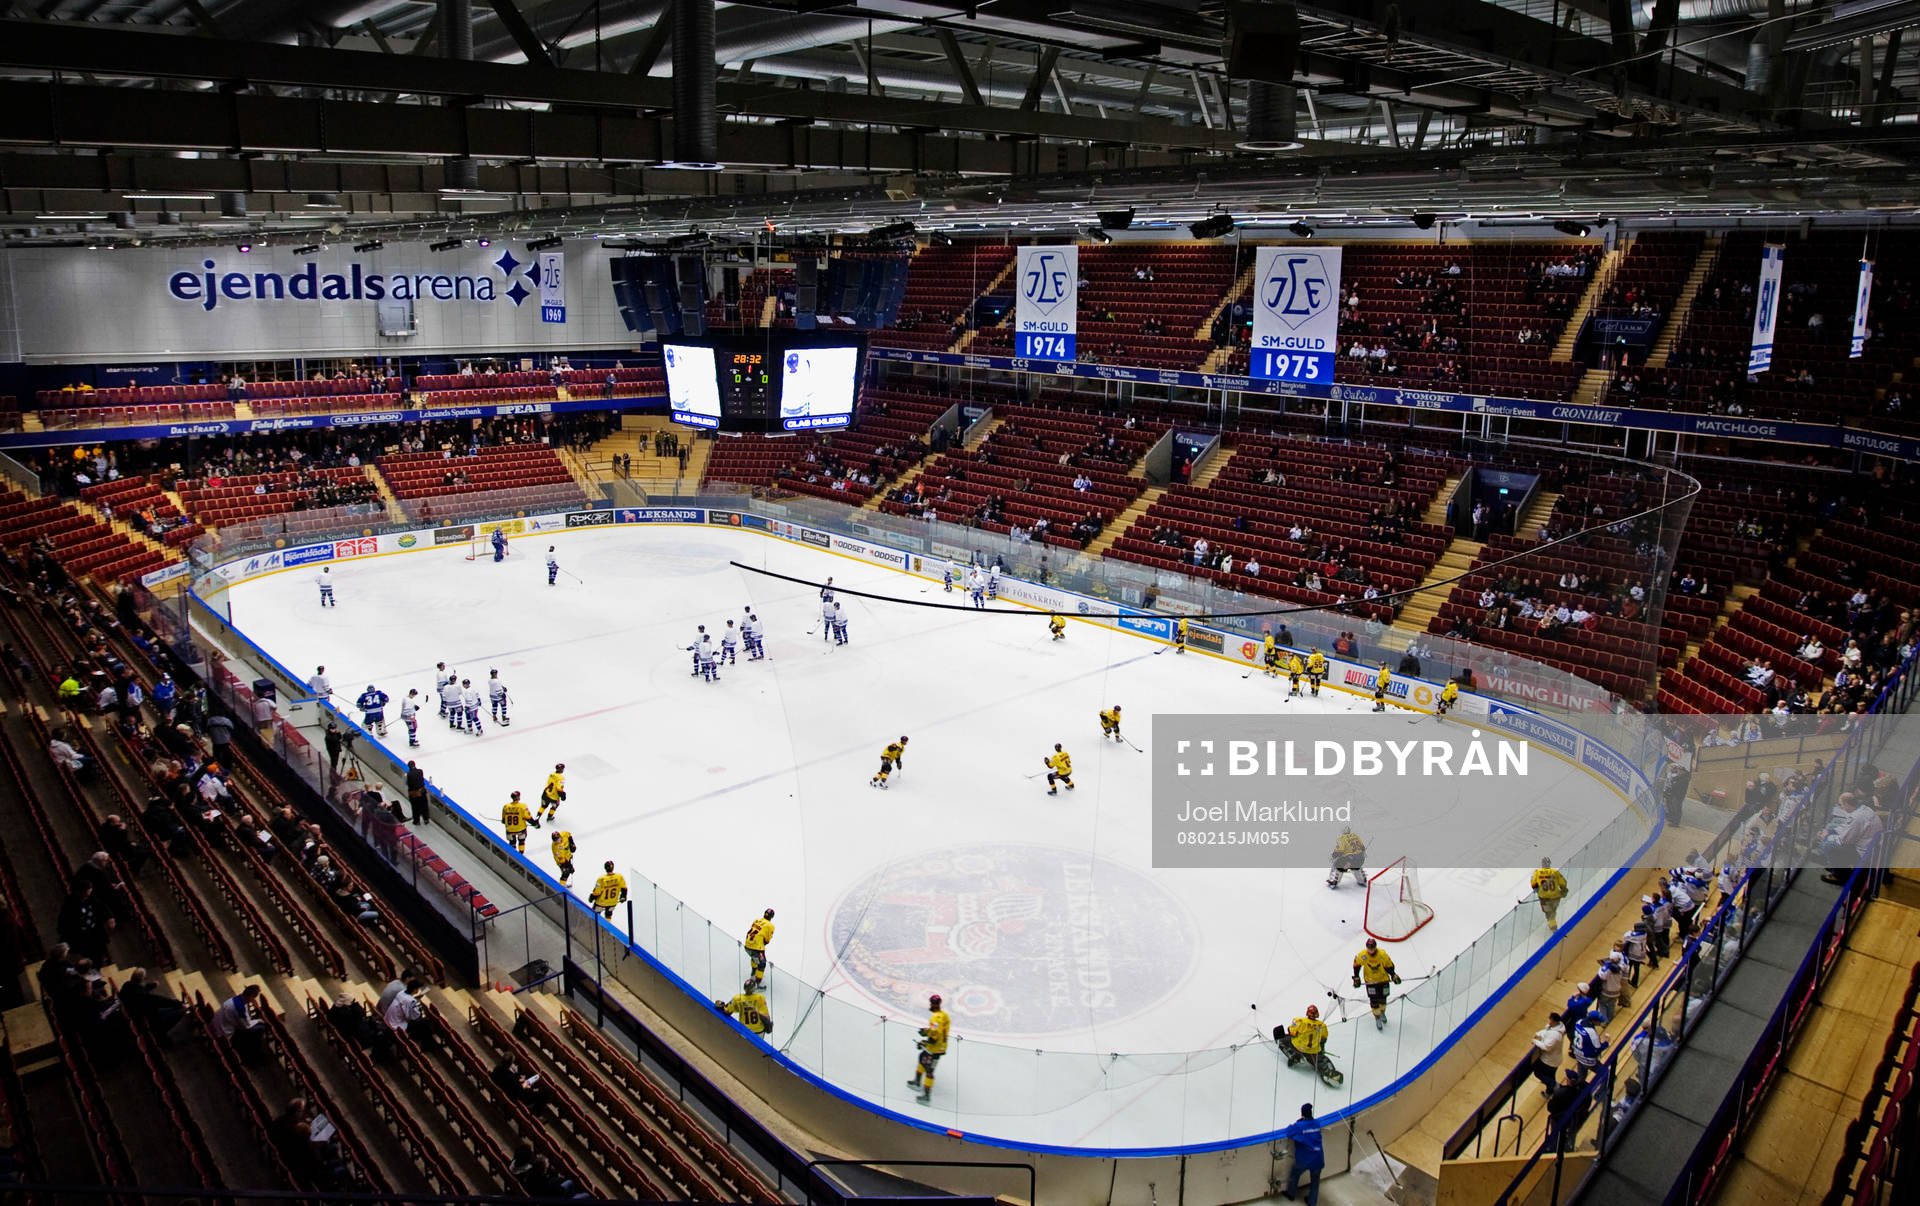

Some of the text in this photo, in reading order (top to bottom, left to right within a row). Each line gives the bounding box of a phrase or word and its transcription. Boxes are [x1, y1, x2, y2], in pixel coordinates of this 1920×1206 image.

[169, 259, 497, 311] ejendals arena
[545, 308, 562, 321] 1969
[1023, 321, 1069, 332] SM-GULD
[1026, 335, 1066, 357] 1974
[1261, 335, 1326, 350] SM-GULD
[733, 354, 762, 364] 28:32
[1011, 359, 1029, 368] CCS
[1265, 353, 1319, 379] 1975
[1404, 391, 1455, 403] TOMOKU
[505, 404, 544, 414] PEAB
[1416, 401, 1442, 409] HUS
[334, 414, 399, 424] CLAS OHLSON
[419, 408, 482, 419] Leksands Sparbank
[1551, 406, 1622, 423] CRONIMET
[786, 418, 811, 428] CLAS
[1696, 420, 1777, 436] MATCHLOGE
[1843, 433, 1900, 453] BASTULOGE
[638, 510, 697, 519] LEKSANDS
[292, 531, 360, 546] Leksands Sparbank
[284, 547, 333, 562] Björnkläder
[837, 540, 866, 554] ODDSET
[874, 550, 905, 564] ODDSET
[1188, 630, 1222, 645] ejendals
[1345, 669, 1410, 697] AUTOEXRTEN
[366, 694, 380, 706] 34
[1485, 675, 1595, 713] VIKING LINE
[1508, 716, 1576, 751] LRF KONSULT
[1585, 743, 1632, 783] Björnkläder
[743, 1010, 759, 1026] 18
